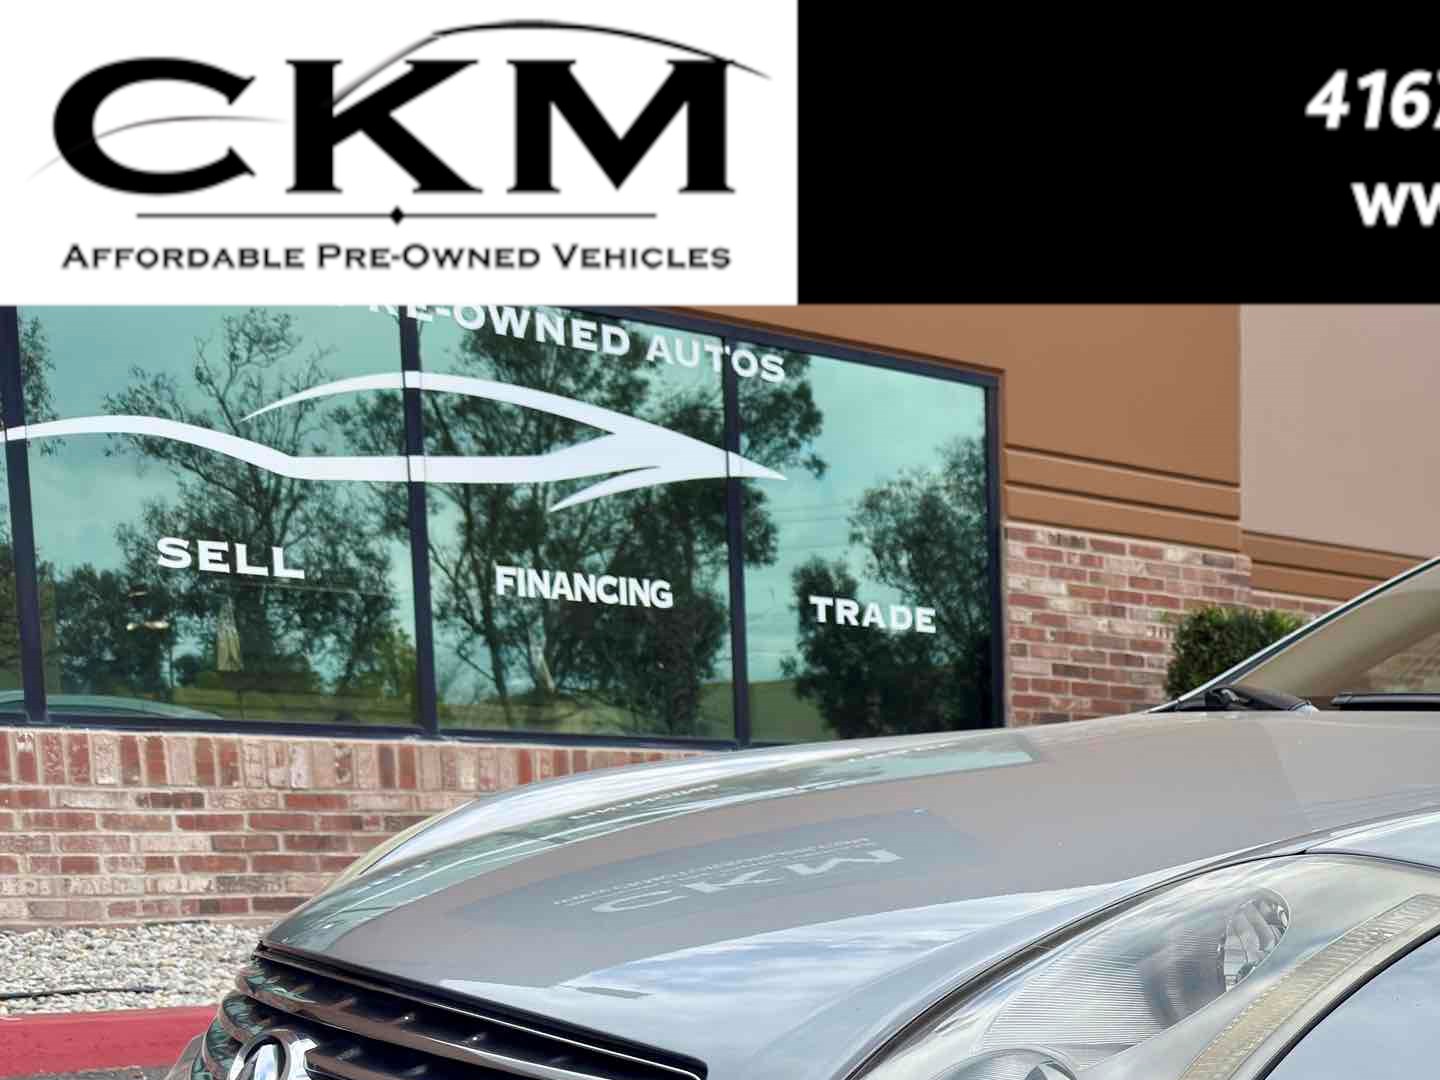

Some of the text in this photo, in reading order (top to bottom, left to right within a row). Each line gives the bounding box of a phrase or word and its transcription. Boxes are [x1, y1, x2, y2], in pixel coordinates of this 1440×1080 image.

[337, 304, 787, 384] E-OWNED AUTOS
[156, 536, 305, 580] SELL
[495, 564, 674, 609] FINANCING
[808, 595, 937, 634] TRADE
